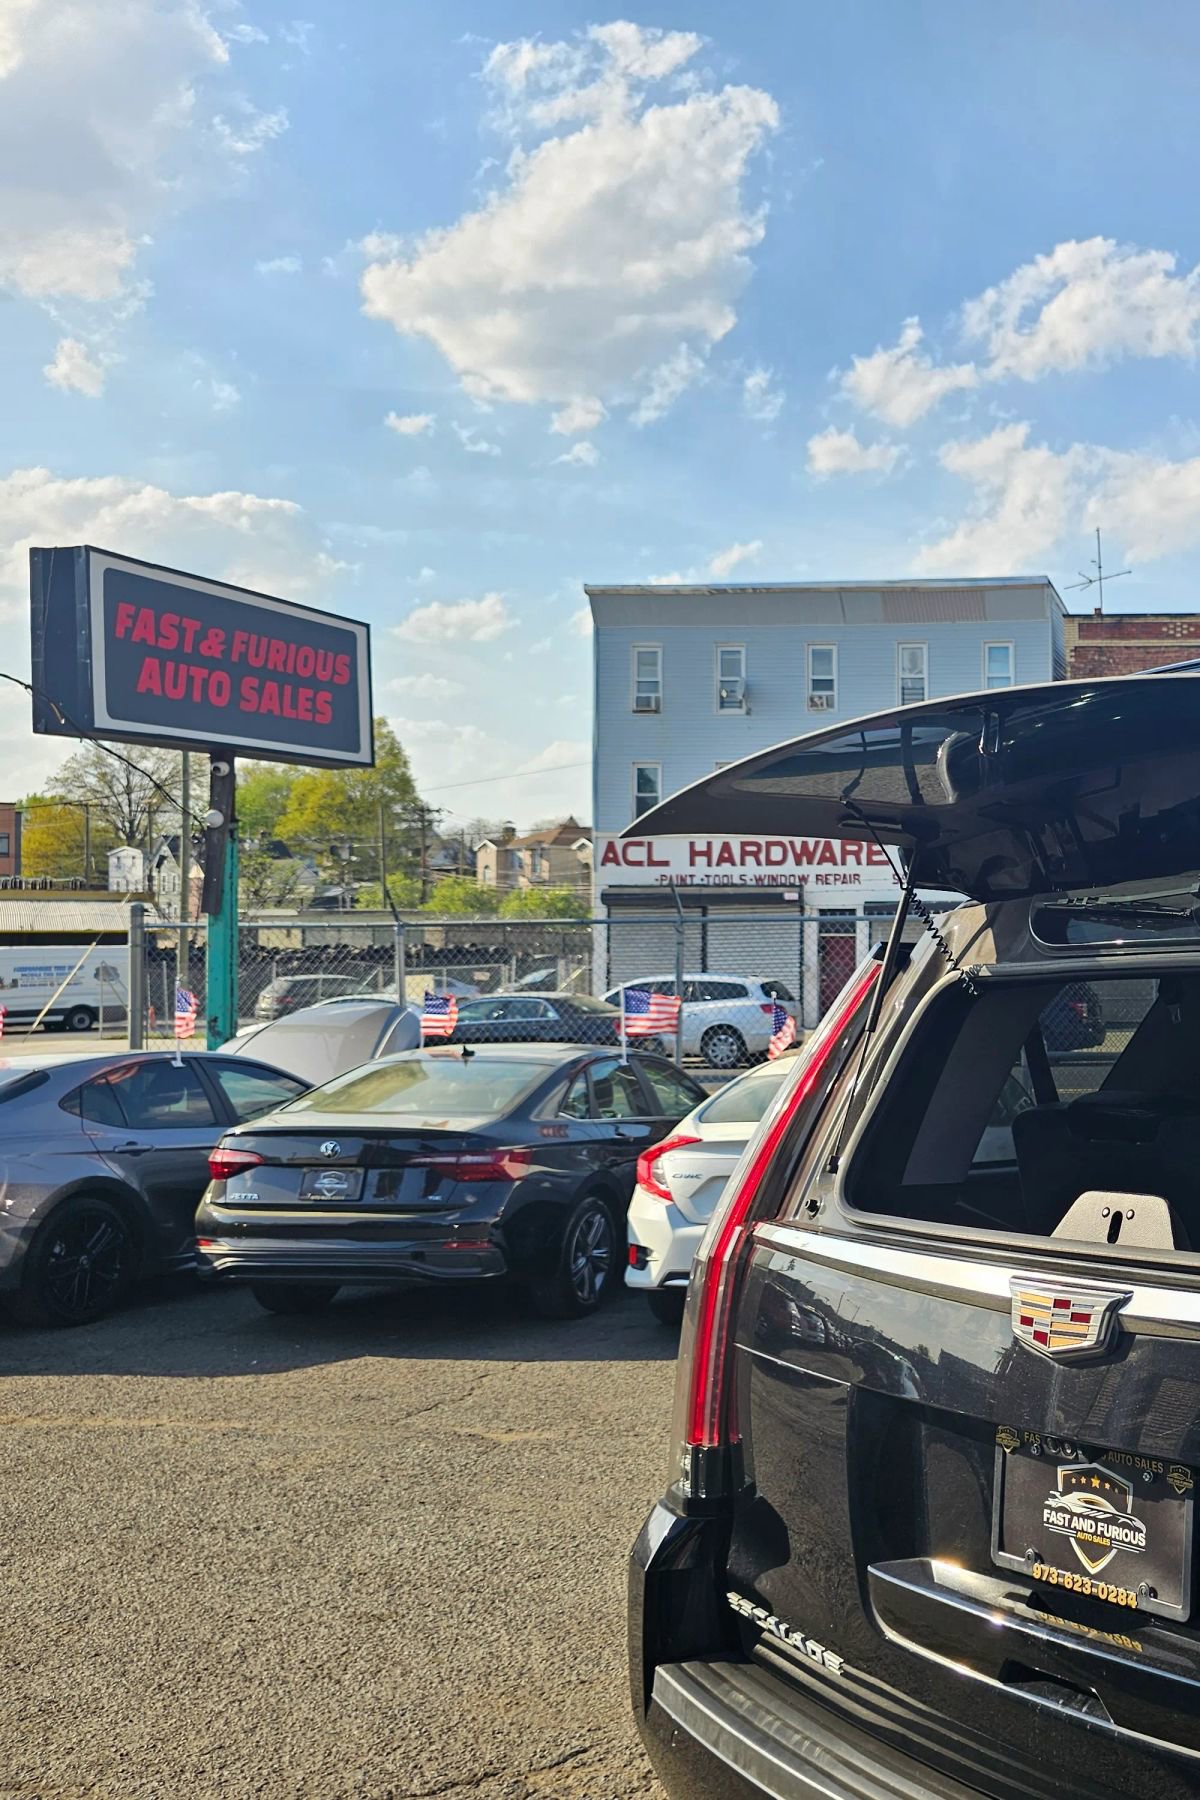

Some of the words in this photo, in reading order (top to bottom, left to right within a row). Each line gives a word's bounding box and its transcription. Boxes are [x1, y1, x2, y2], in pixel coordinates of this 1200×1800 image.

[115, 603, 203, 653] FAST
[199, 628, 227, 659] &
[231, 630, 350, 685] FURIOUS
[137, 657, 231, 708] AUTO
[239, 676, 333, 725] SALES
[601, 841, 670, 867] ACL
[689, 840, 889, 867] HARDWARE
[816, 874, 861, 885] REPAIR
[1024, 1431, 1041, 1444] FAS
[1108, 1451, 1132, 1466] AUTO
[1134, 1457, 1163, 1474] SALES
[1043, 1509, 1071, 1527] FAST
[1071, 1516, 1096, 1534] AND
[1097, 1522, 1146, 1546] FURIOUS
[1076, 1531, 1092, 1542] AUTO
[1093, 1535, 1111, 1546] SALES
[1032, 1562, 1138, 1609] 973-623-0284
[726, 1591, 845, 1675] ESCALADE
